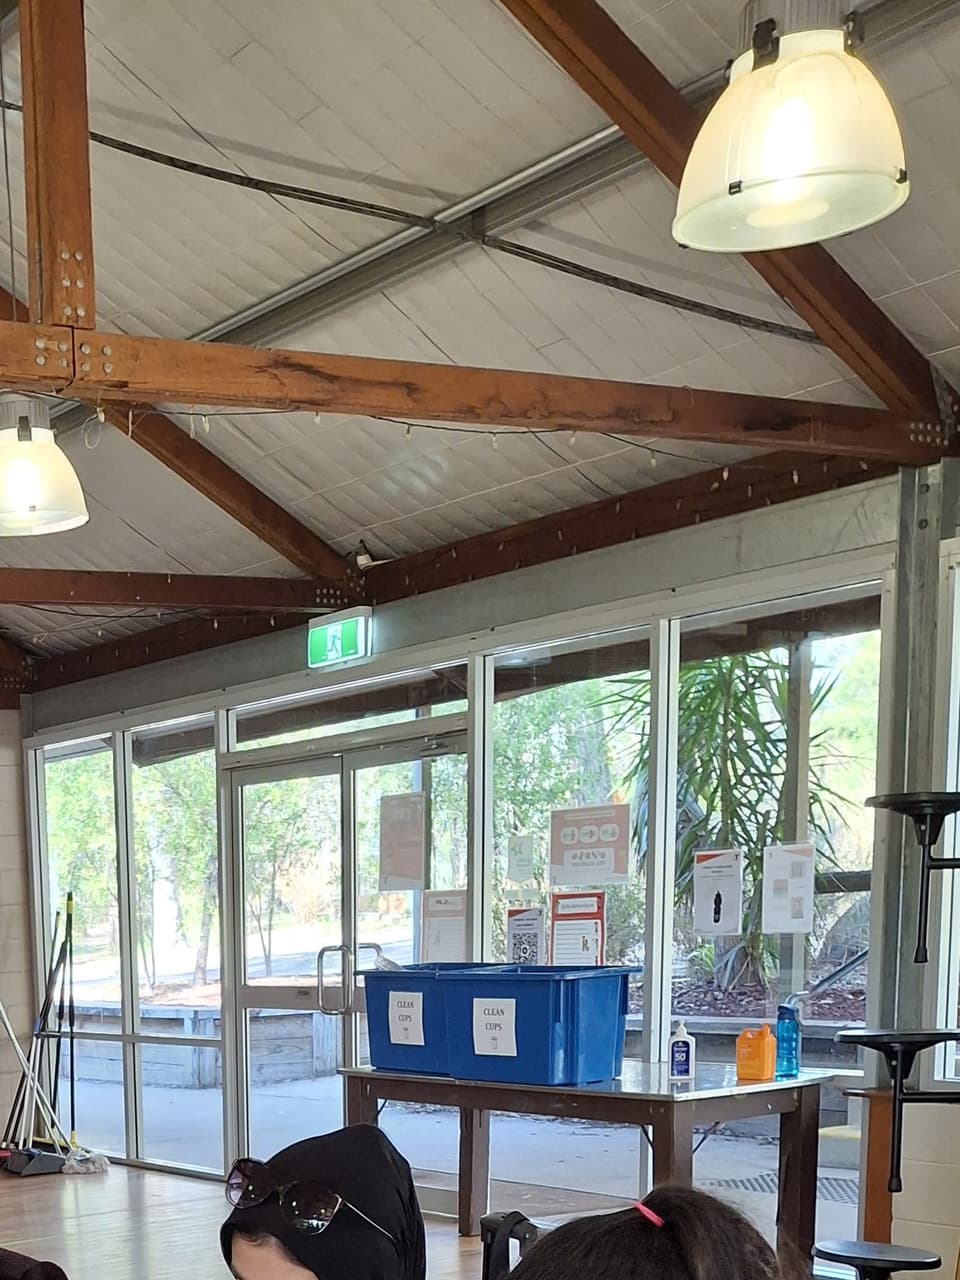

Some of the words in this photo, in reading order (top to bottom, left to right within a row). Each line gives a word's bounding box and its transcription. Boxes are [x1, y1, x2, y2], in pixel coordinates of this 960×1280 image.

[397, 1001, 414, 1009] CLEAN
[483, 1008, 505, 1017] CLEAN
[398, 1014, 413, 1022] CUPS
[485, 1023, 503, 1031] CUPS
